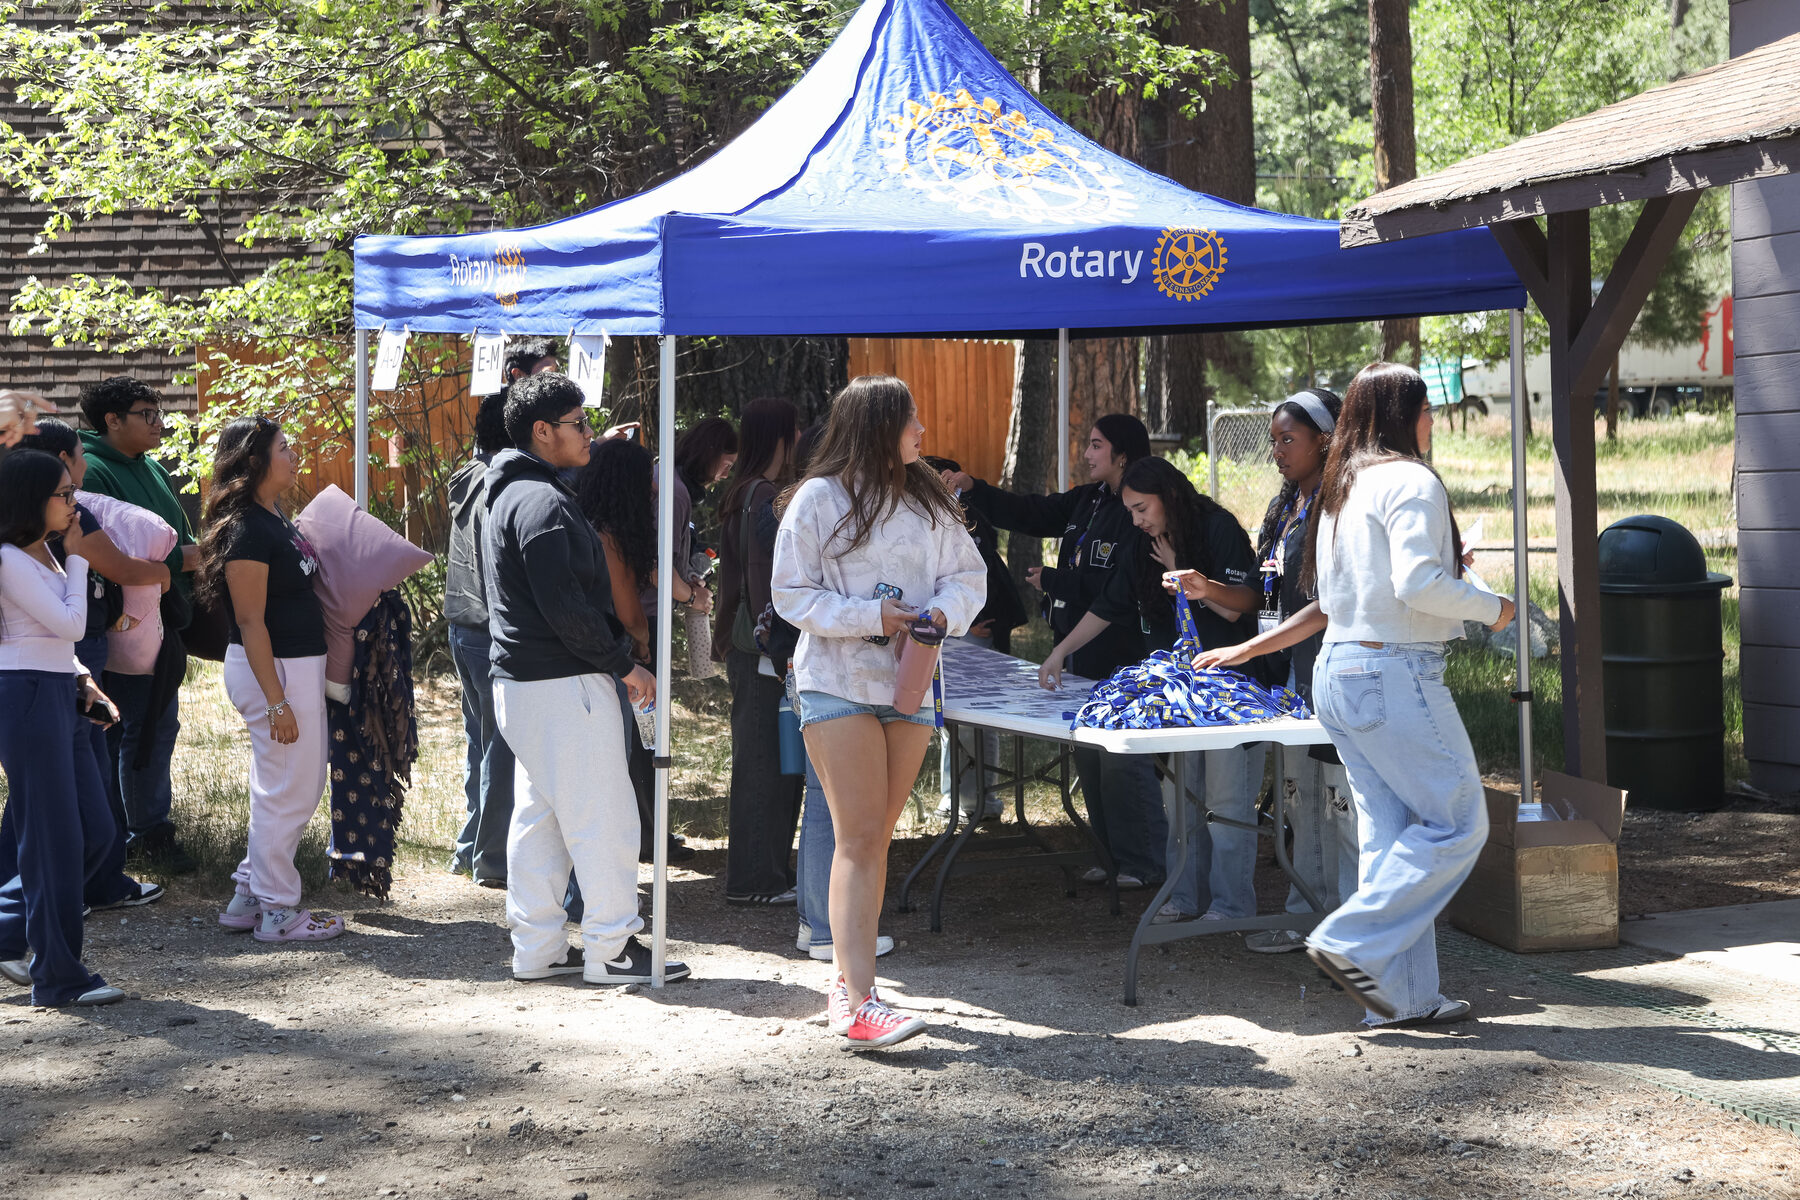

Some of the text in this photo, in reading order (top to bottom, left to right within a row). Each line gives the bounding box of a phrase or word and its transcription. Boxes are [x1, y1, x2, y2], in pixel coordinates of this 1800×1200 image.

[450, 254, 494, 291] Rotary
[1019, 243, 1143, 284] Rotary
[1162, 273, 1214, 293] INTERNATIONAL
[380, 345, 401, 369] A-D
[477, 343, 500, 372] E-M
